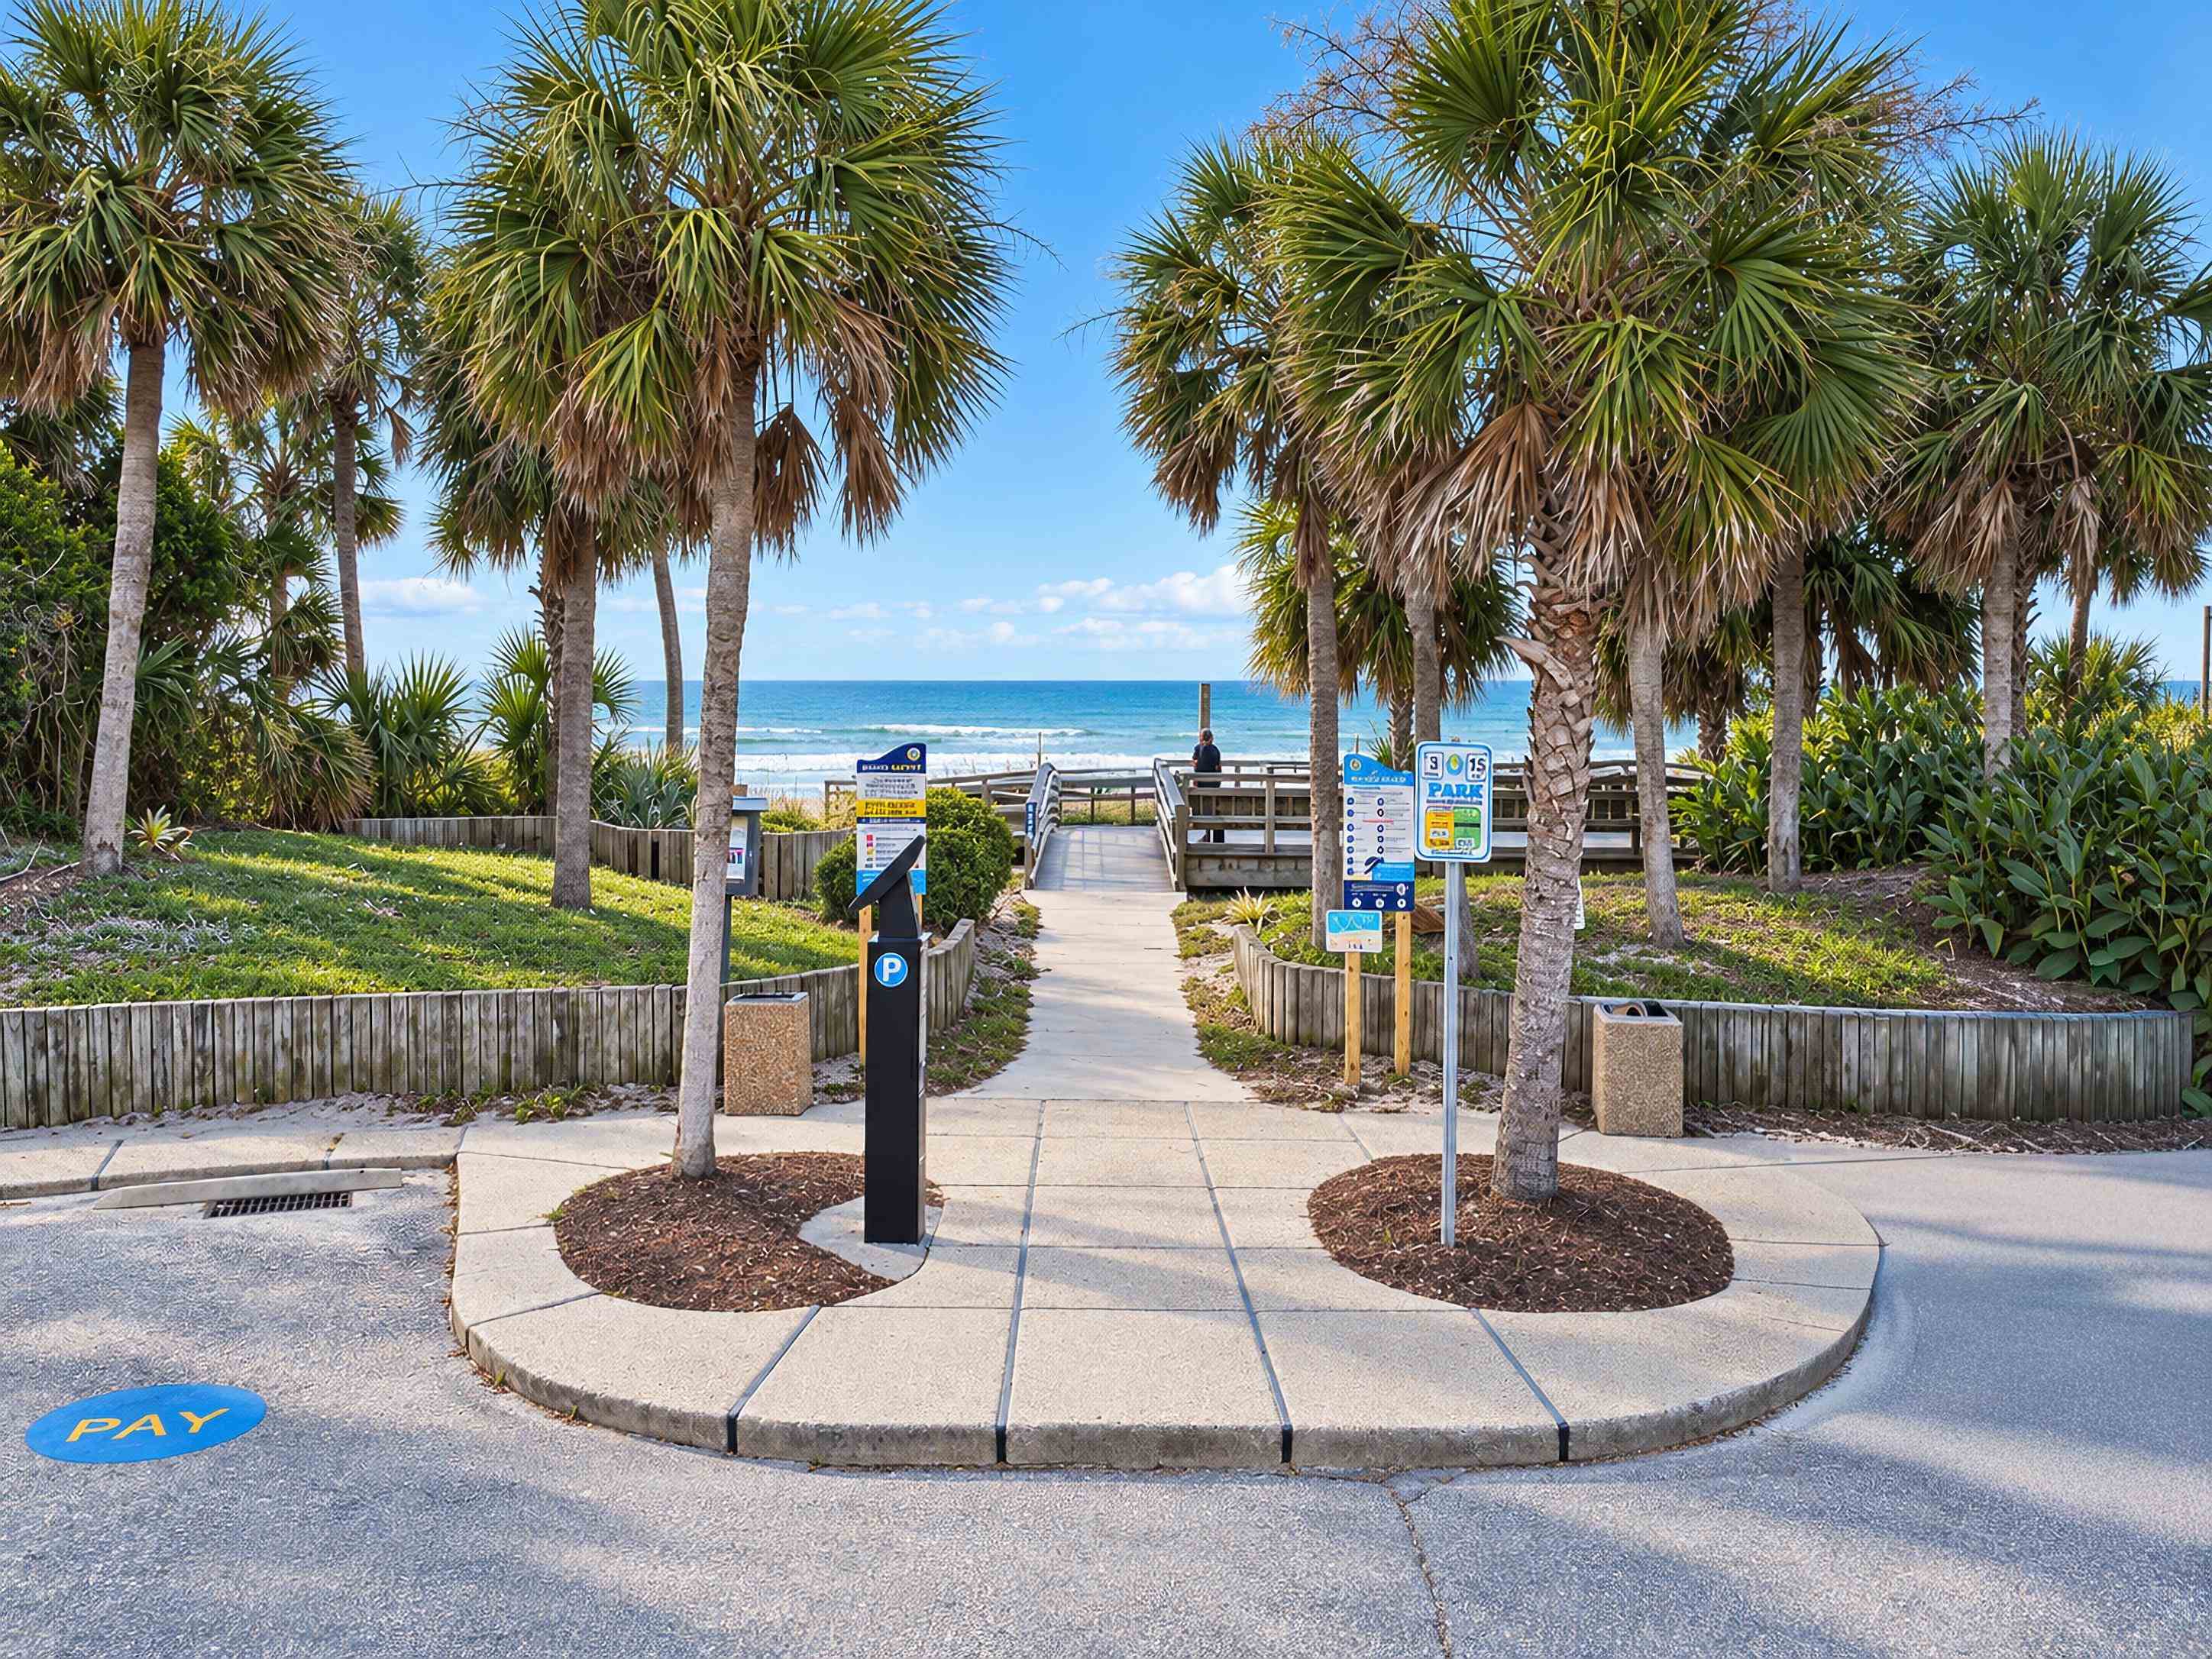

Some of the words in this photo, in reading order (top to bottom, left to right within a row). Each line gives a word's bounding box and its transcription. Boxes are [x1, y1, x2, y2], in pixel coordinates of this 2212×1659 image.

[1428, 782, 1483, 799] PARK
[882, 957, 902, 982] P
[65, 1408, 230, 1443] PAY
